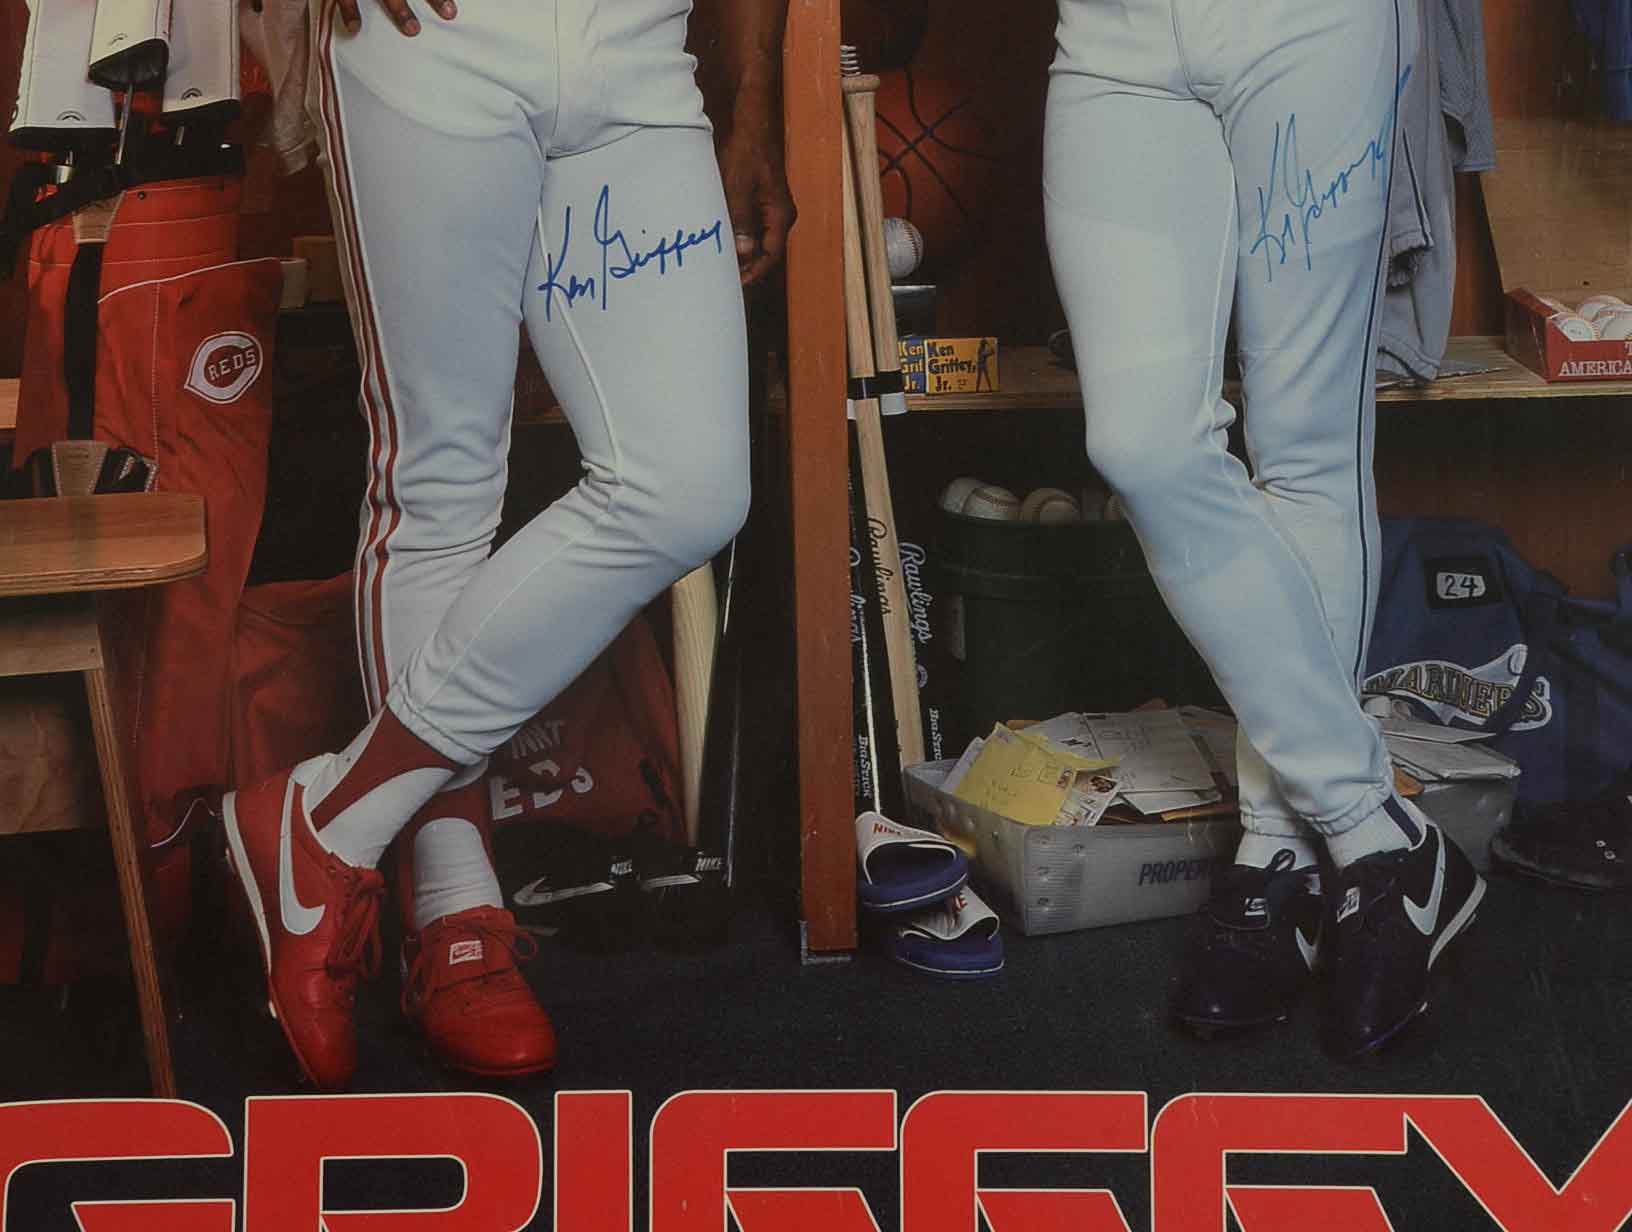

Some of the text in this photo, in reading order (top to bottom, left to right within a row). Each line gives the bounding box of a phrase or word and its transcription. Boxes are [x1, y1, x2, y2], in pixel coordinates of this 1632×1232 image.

[207, 347, 257, 381] REDS
[927, 341, 954, 358] Ken
[935, 376, 953, 393] Jr.
[866, 517, 893, 617] Rawlings
[898, 541, 933, 644] Rawlings
[1444, 574, 1479, 599] 24
